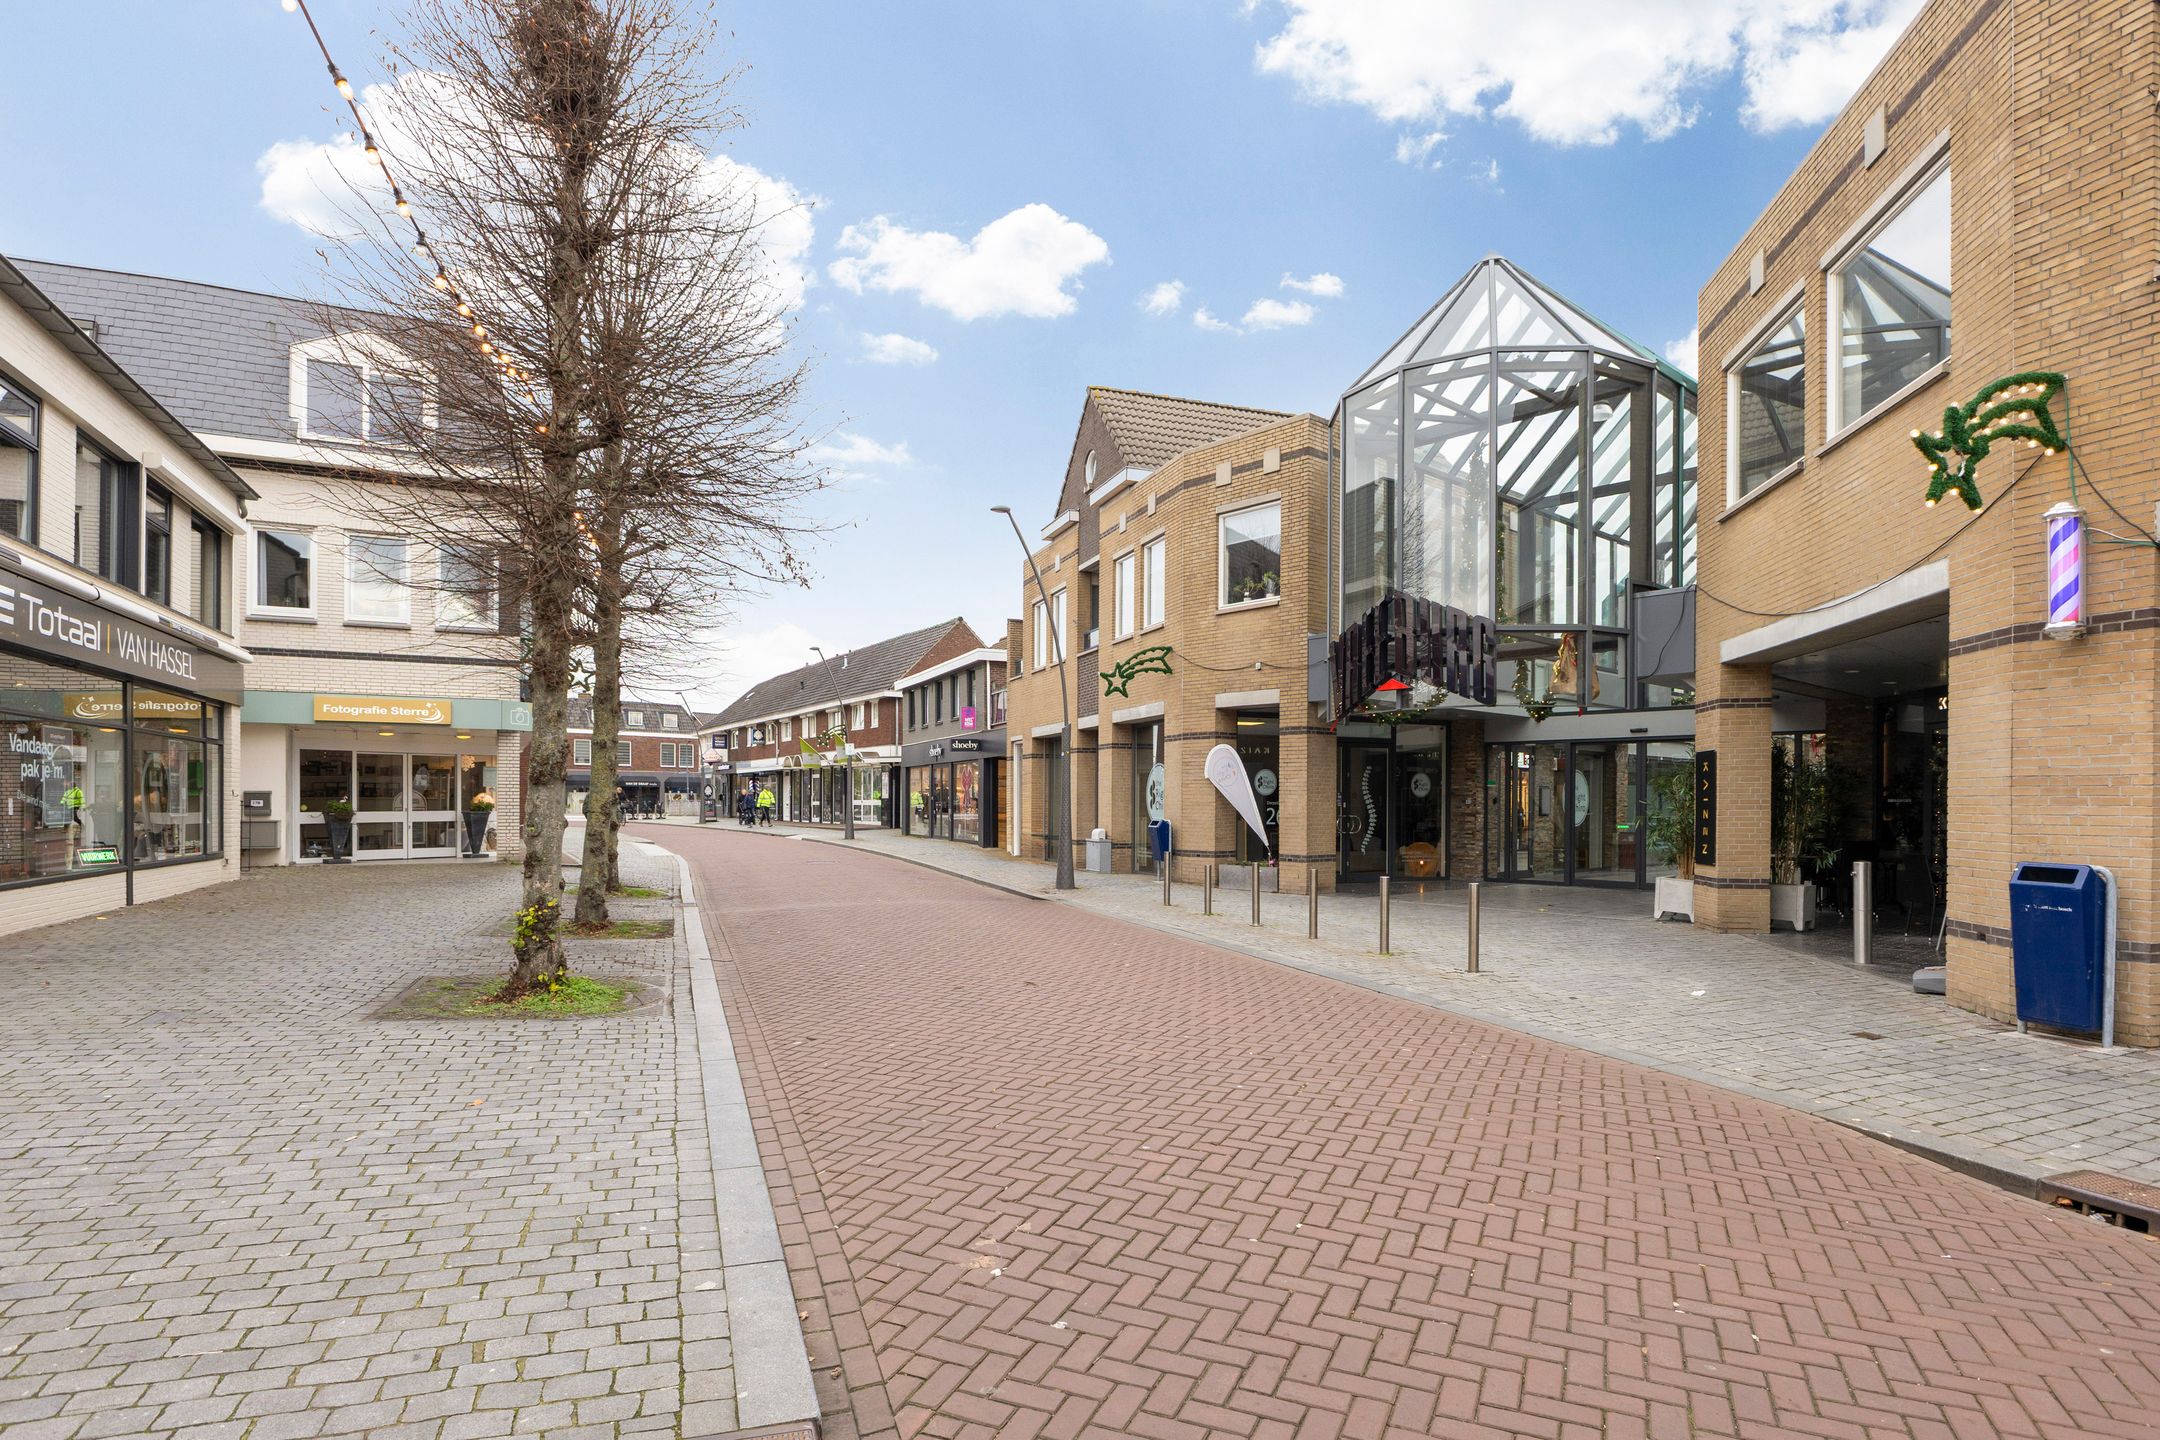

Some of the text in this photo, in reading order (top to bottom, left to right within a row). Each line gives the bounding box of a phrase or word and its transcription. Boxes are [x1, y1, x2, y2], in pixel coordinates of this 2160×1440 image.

[20, 592, 101, 652] Totaal
[117, 627, 147, 665] VAN
[150, 640, 197, 680] HASSEL
[323, 703, 429, 716] Fotografie Sterre
[9, 732, 54, 761] Vandaag
[952, 740, 979, 751] shoeby
[20, 759, 40, 782] pak
[40, 760, 51, 782] je
